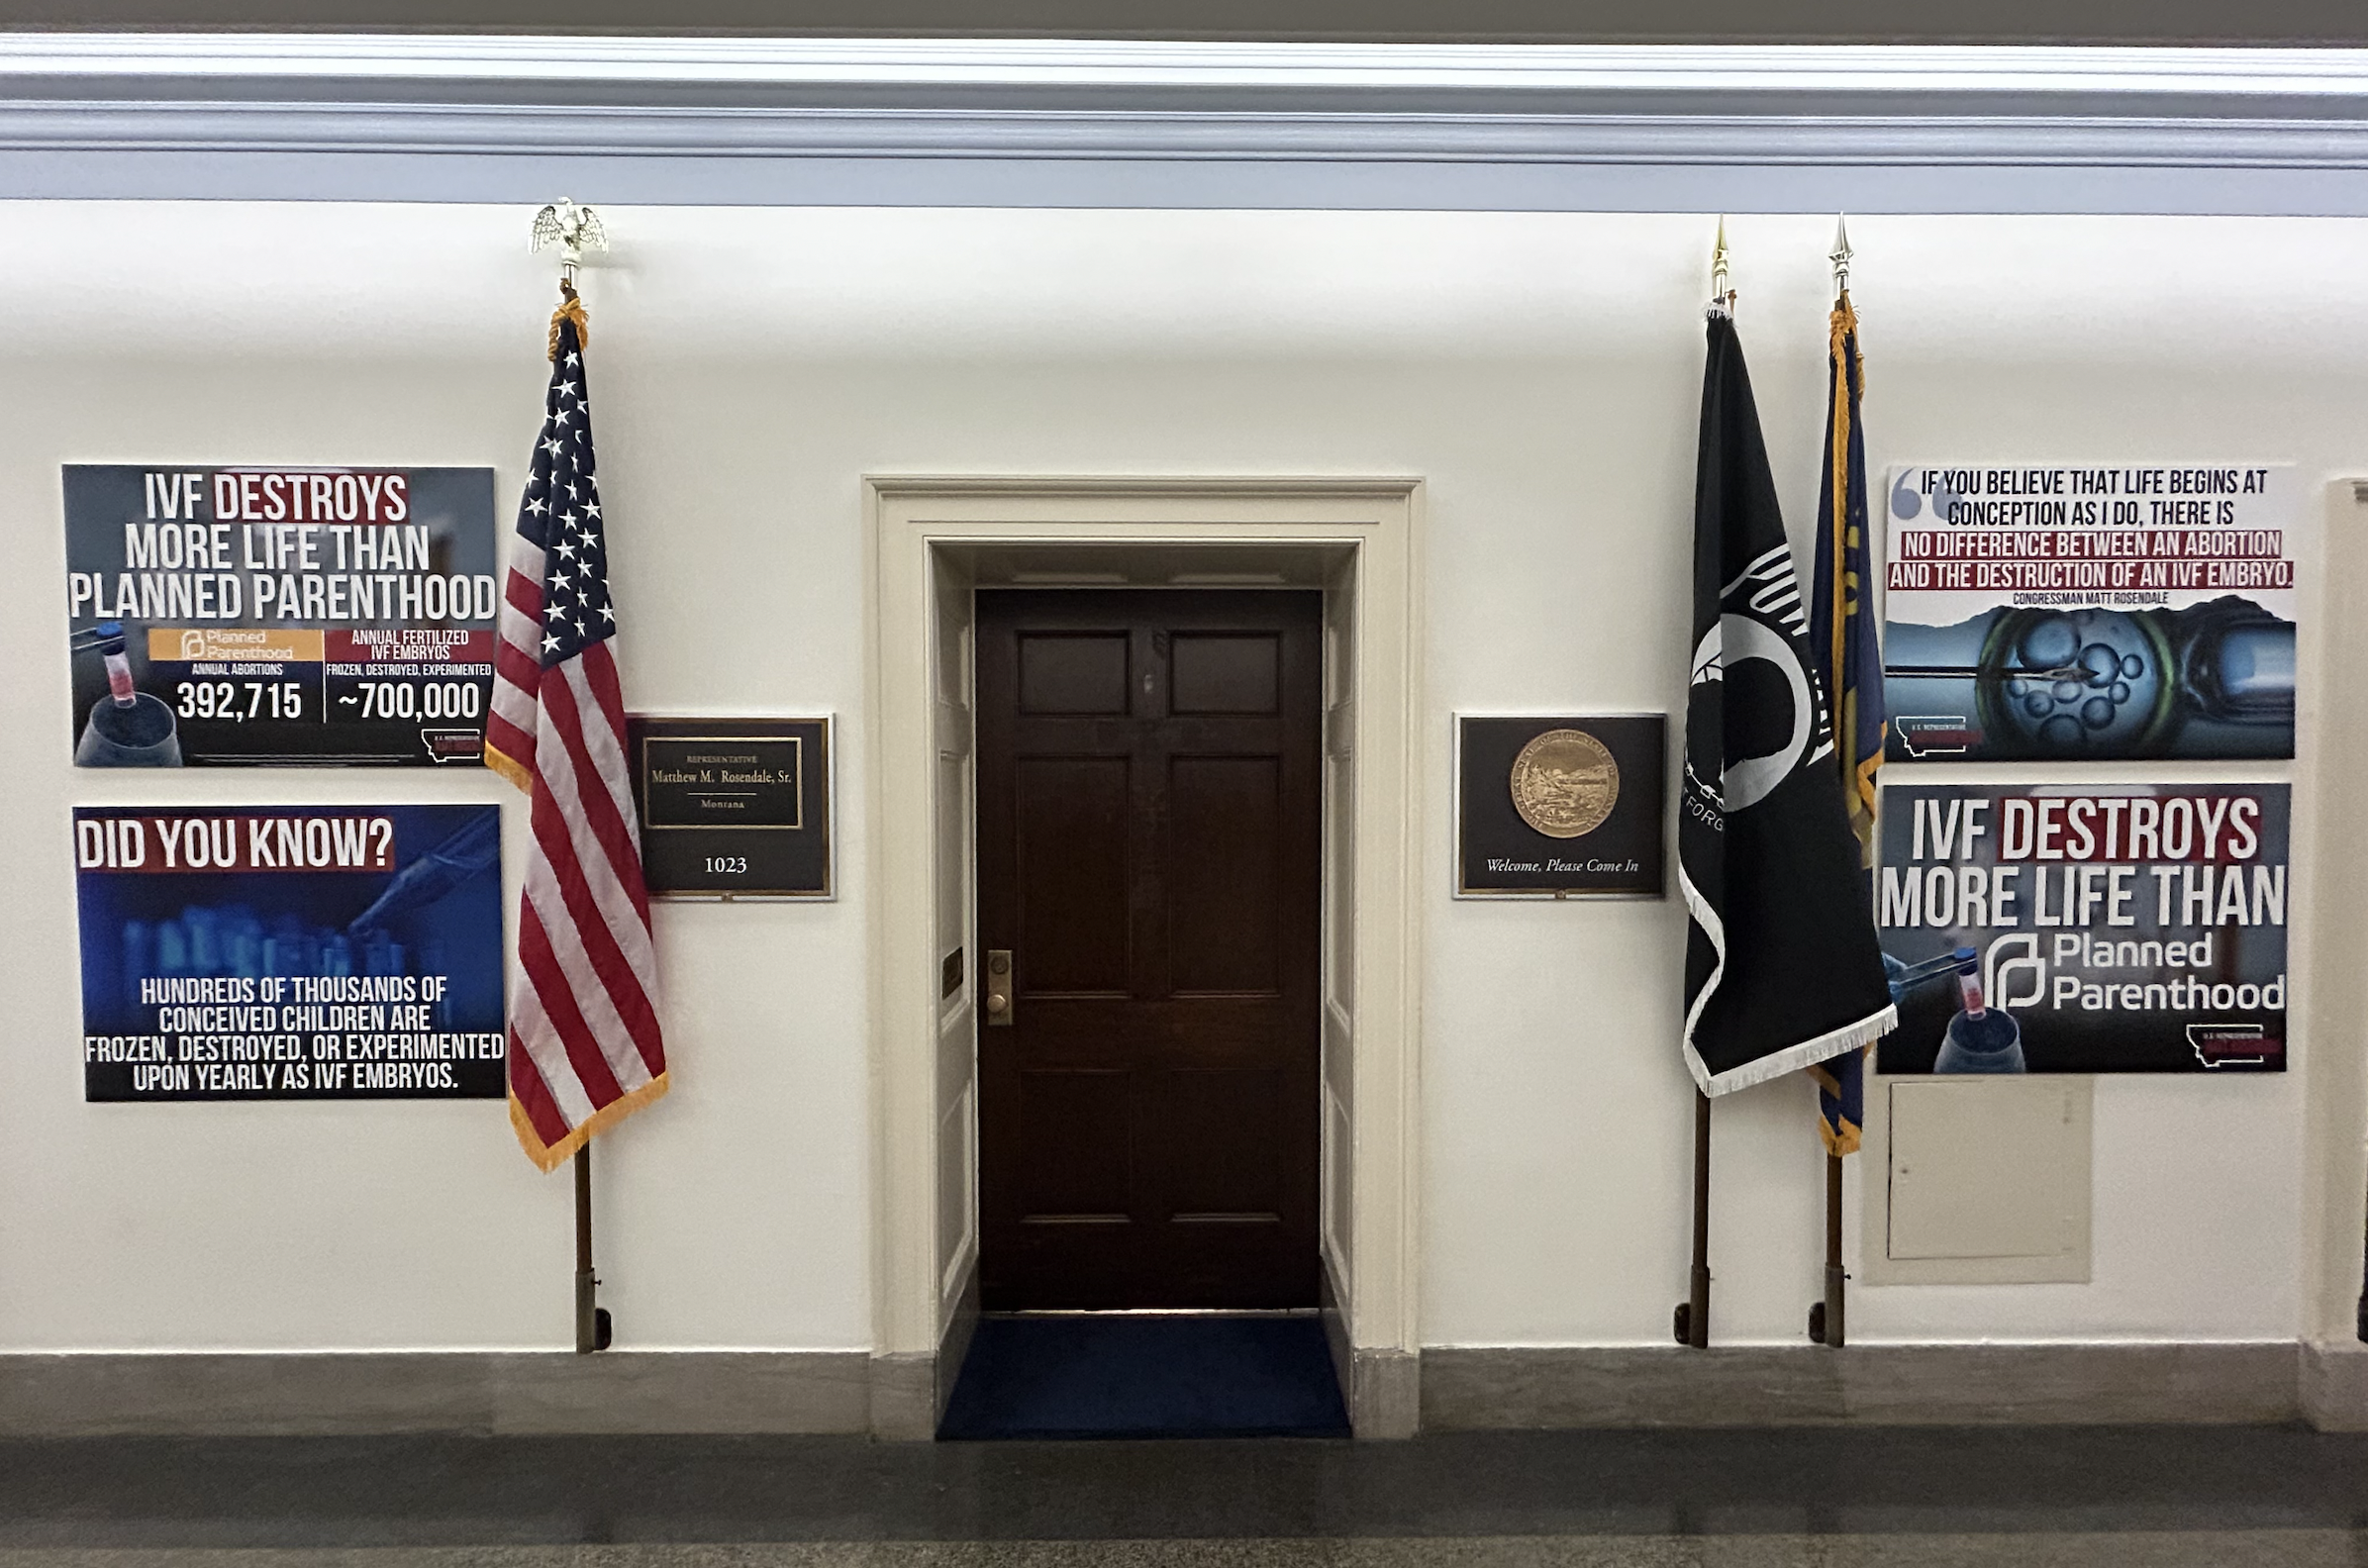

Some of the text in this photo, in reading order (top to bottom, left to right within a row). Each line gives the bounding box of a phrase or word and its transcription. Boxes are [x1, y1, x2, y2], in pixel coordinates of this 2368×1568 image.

[1921, 469, 2267, 495] IF YOU BELIEVE THAT LIFE BEGINS AT
[146, 473, 407, 521] IVF DESTROYS
[1948, 501, 2233, 528] CONCEPTION AS I DO, THERE IS
[125, 525, 429, 571] MORE LIFE THAN
[1905, 532, 2280, 557] NO DIFFERENCE BETWEEN AN ABORTION
[1890, 561, 2294, 588] AND THE DESTRUCTION OF AN IVF EMBRYO.
[70, 573, 496, 620] PLANNED PARENTHOOD
[2014, 593, 2168, 604] CONGRESSMAN MATT ROSENDALE
[206, 630, 265, 643] Planned
[352, 631, 468, 644] ANNUAL FERTILIZED
[208, 645, 293, 659] Parenthood
[371, 645, 449, 660] IVF EMBRYOS
[192, 663, 283, 675] ANNUAL ABORTIONS
[327, 664, 491, 676] FROZEN, DESTROYED, EXPERIMENTED
[177, 682, 301, 723] 392,715
[339, 683, 479, 723] ~700,000
[652, 770, 791, 784] Matthew M. Rosendale, Sr.
[702, 800, 744, 809] Montana
[1913, 798, 2259, 860] IVF DESTROYS
[77, 818, 393, 868] DID YOU KNOW?
[705, 857, 746, 873] 1023
[1487, 859, 1638, 872] Welcome, Please Come In
[1881, 865, 2285, 927] MORE LIFE THAN
[2053, 932, 2213, 967] Planned
[141, 976, 446, 1004] HUNDREDS OF THOUSANDS OF
[2053, 975, 2285, 1011] Parenthood
[158, 1005, 431, 1032] CONCEIVED CHILDREN ARE
[85, 1034, 505, 1064] FROZEN, DESTROYED, OR EXPERIMENTED
[133, 1062, 458, 1091] UPON YEARLY AS IVF EMBRYOS.
